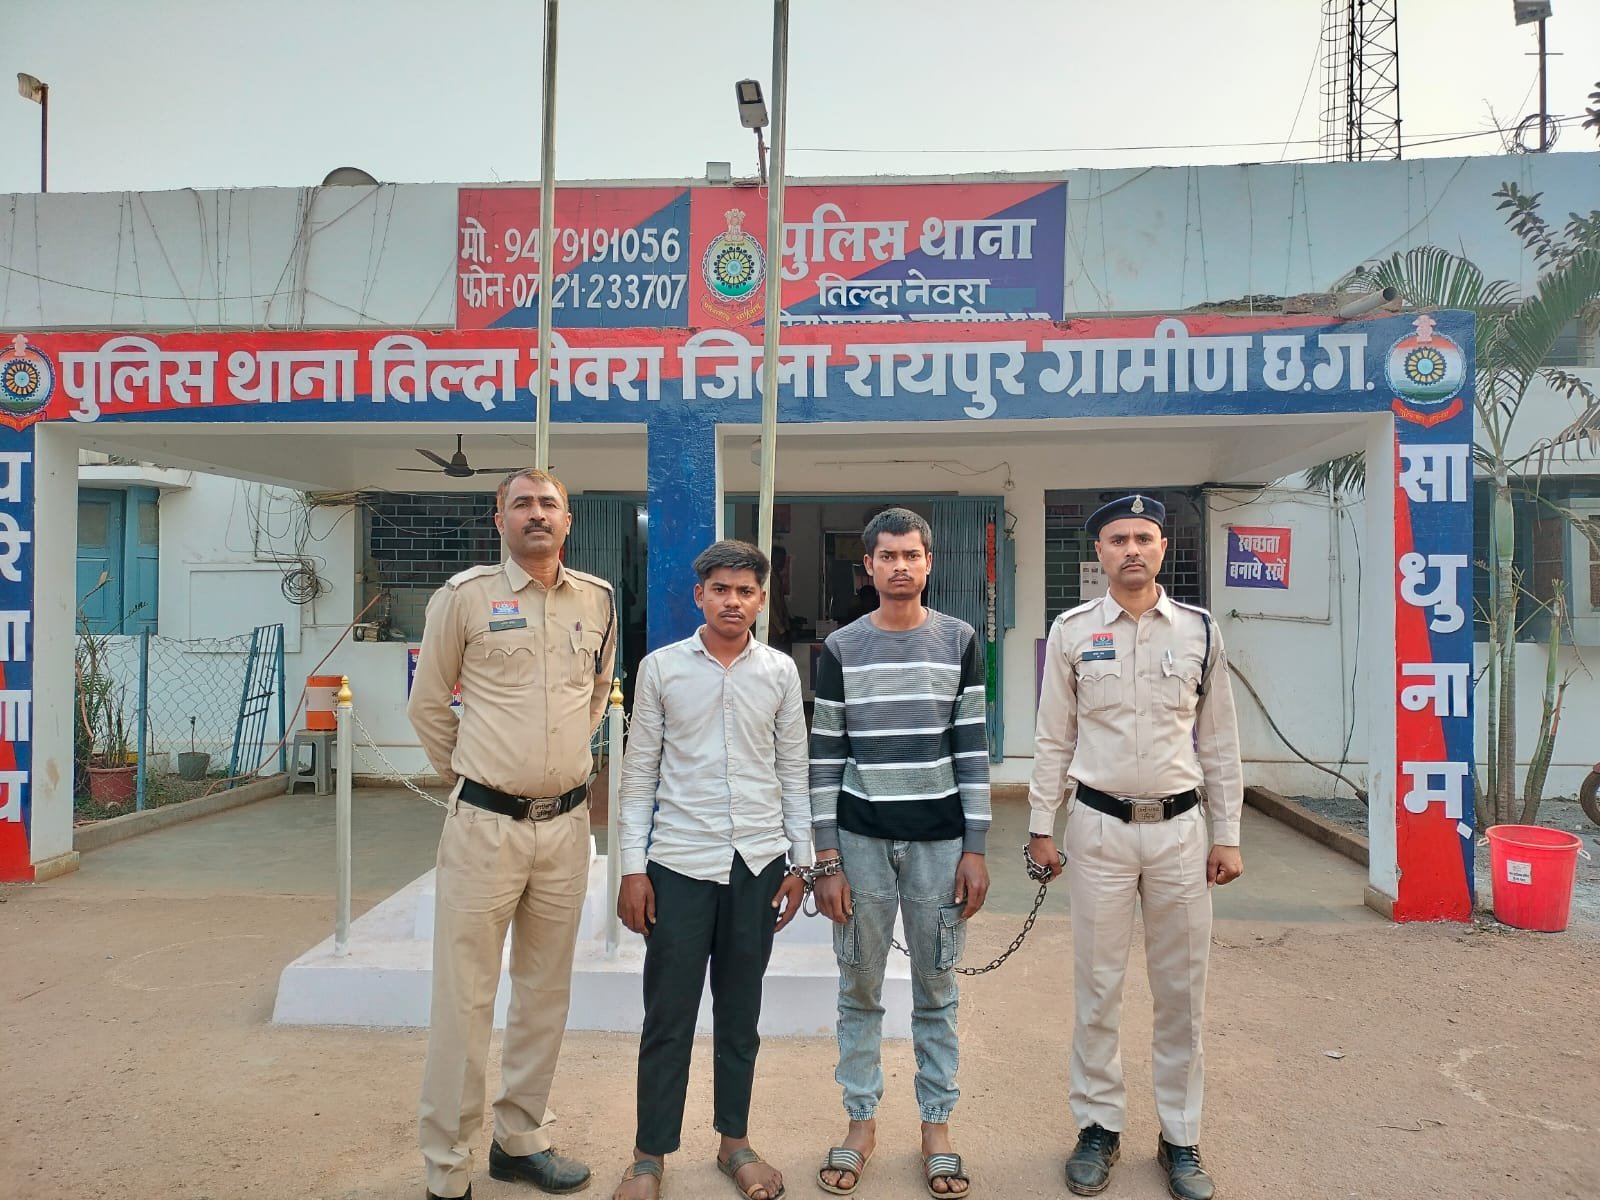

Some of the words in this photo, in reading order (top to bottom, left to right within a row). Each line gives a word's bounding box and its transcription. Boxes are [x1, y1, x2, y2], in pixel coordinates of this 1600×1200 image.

[780, 203, 909, 281] पुलिस
[920, 216, 1037, 260] थाना
[816, 272, 902, 308] तिल्दा
[905, 268, 991, 305] नेवरा
[58, 335, 219, 423] पुलिस
[227, 349, 359, 403] थाना
[368, 334, 520, 411] तिल्दा
[527, 331, 664, 402] नेवरा
[678, 328, 832, 400] जिला
[845, 340, 1027, 419] रायपुर
[1040, 318, 1253, 396] ग्रामीण
